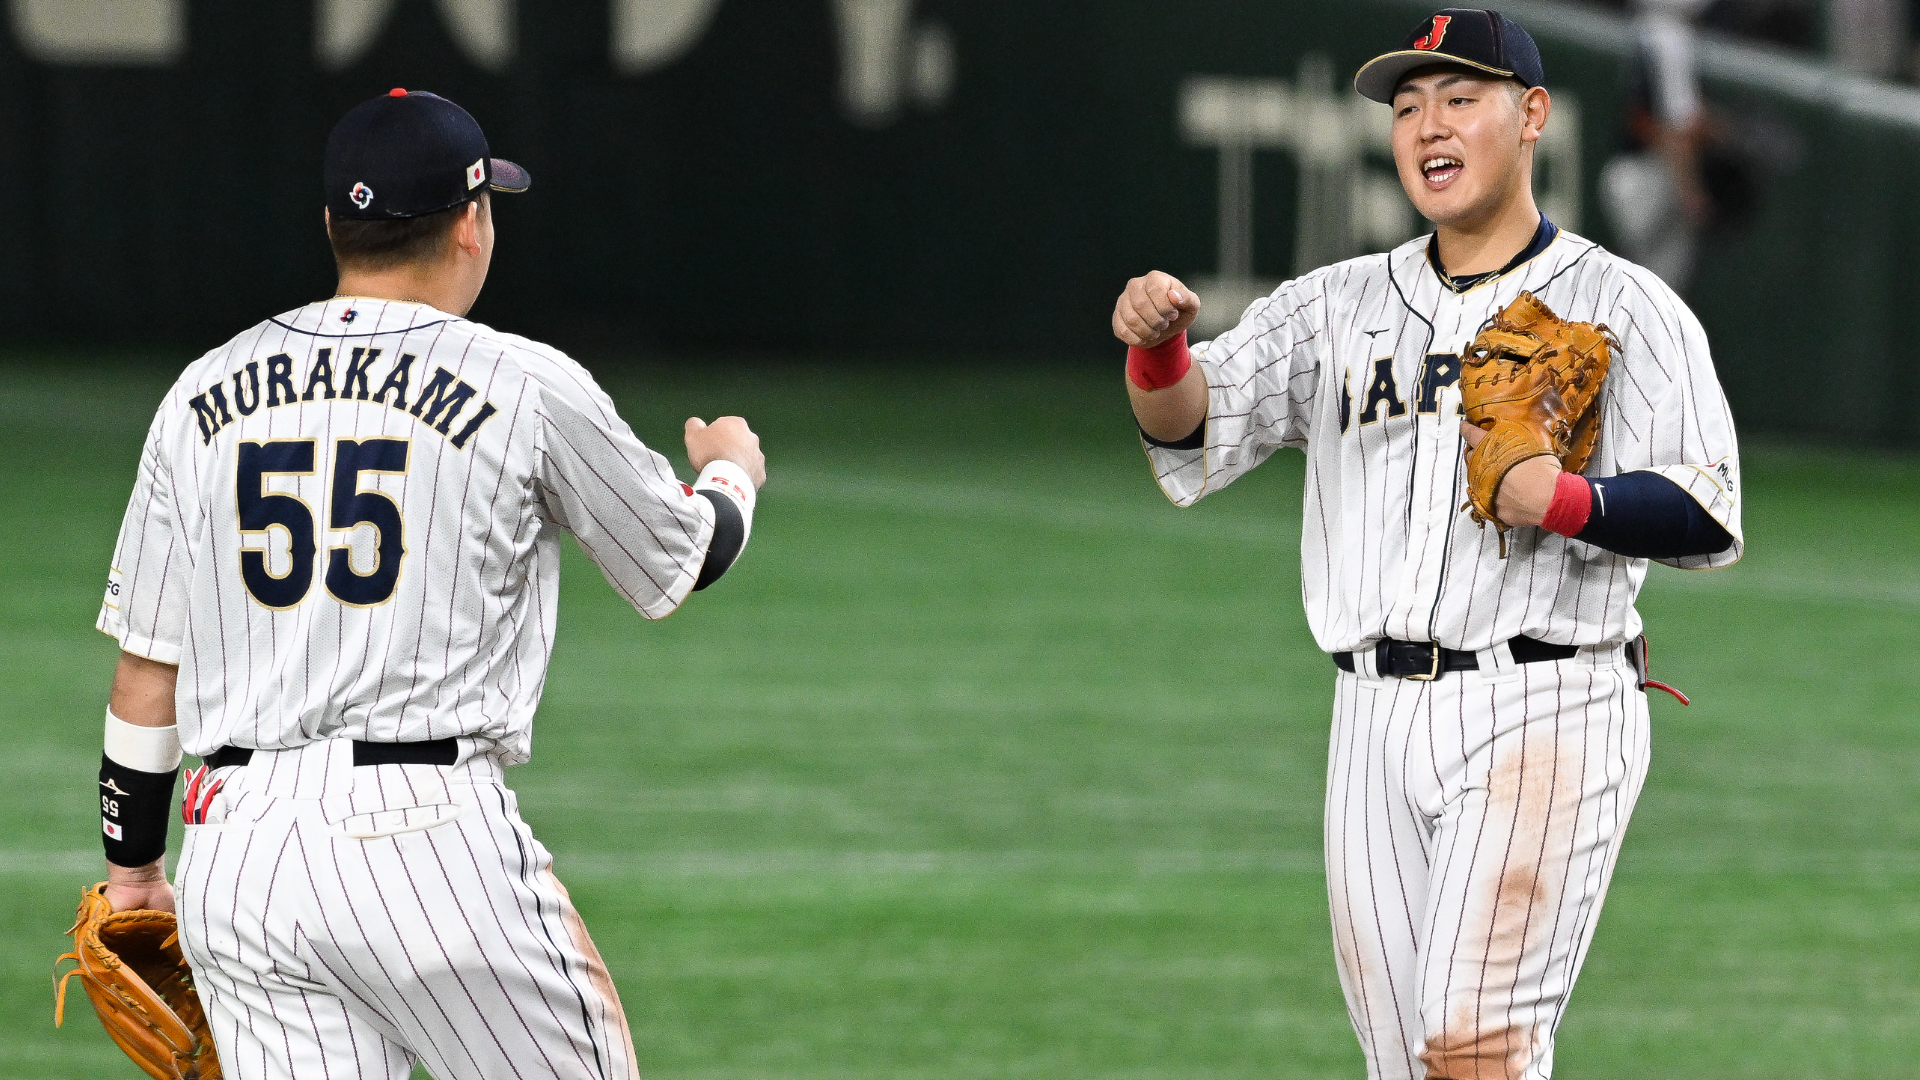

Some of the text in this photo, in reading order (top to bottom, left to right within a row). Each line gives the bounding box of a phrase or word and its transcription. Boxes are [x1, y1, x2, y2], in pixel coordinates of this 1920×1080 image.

[1413, 15, 1452, 51] J
[188, 346, 499, 450] MURAKAMI
[235, 436, 409, 612] 55
